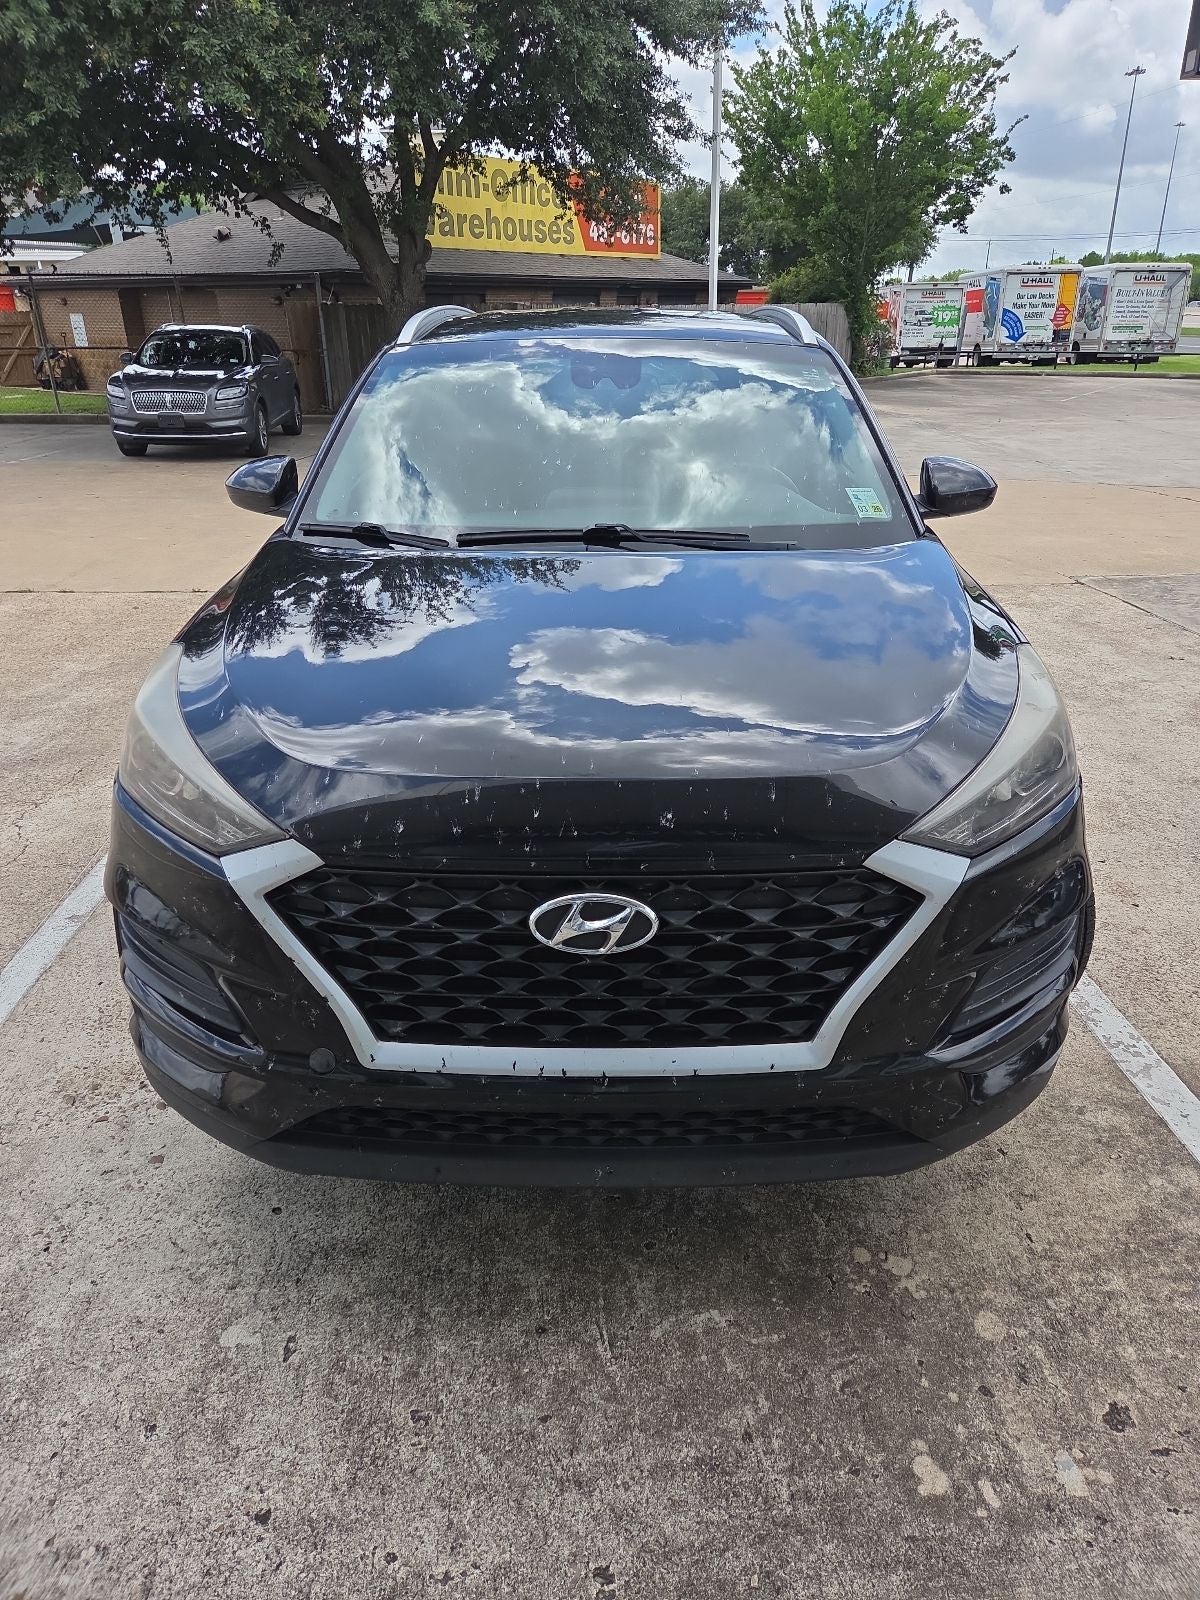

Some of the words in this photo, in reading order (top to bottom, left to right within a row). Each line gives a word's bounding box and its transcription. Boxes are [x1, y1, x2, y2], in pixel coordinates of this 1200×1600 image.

[438, 168, 562, 209] ini-Offic
[427, 207, 575, 245] arehouses
[1021, 276, 1054, 284] U-HAUL
[1134, 274, 1167, 282] U-HAUL
[1016, 292, 1026, 300] Our
[1039, 292, 1055, 300] Decks
[1012, 302, 1027, 310] Make
[1024, 311, 1046, 319] EASIER!
